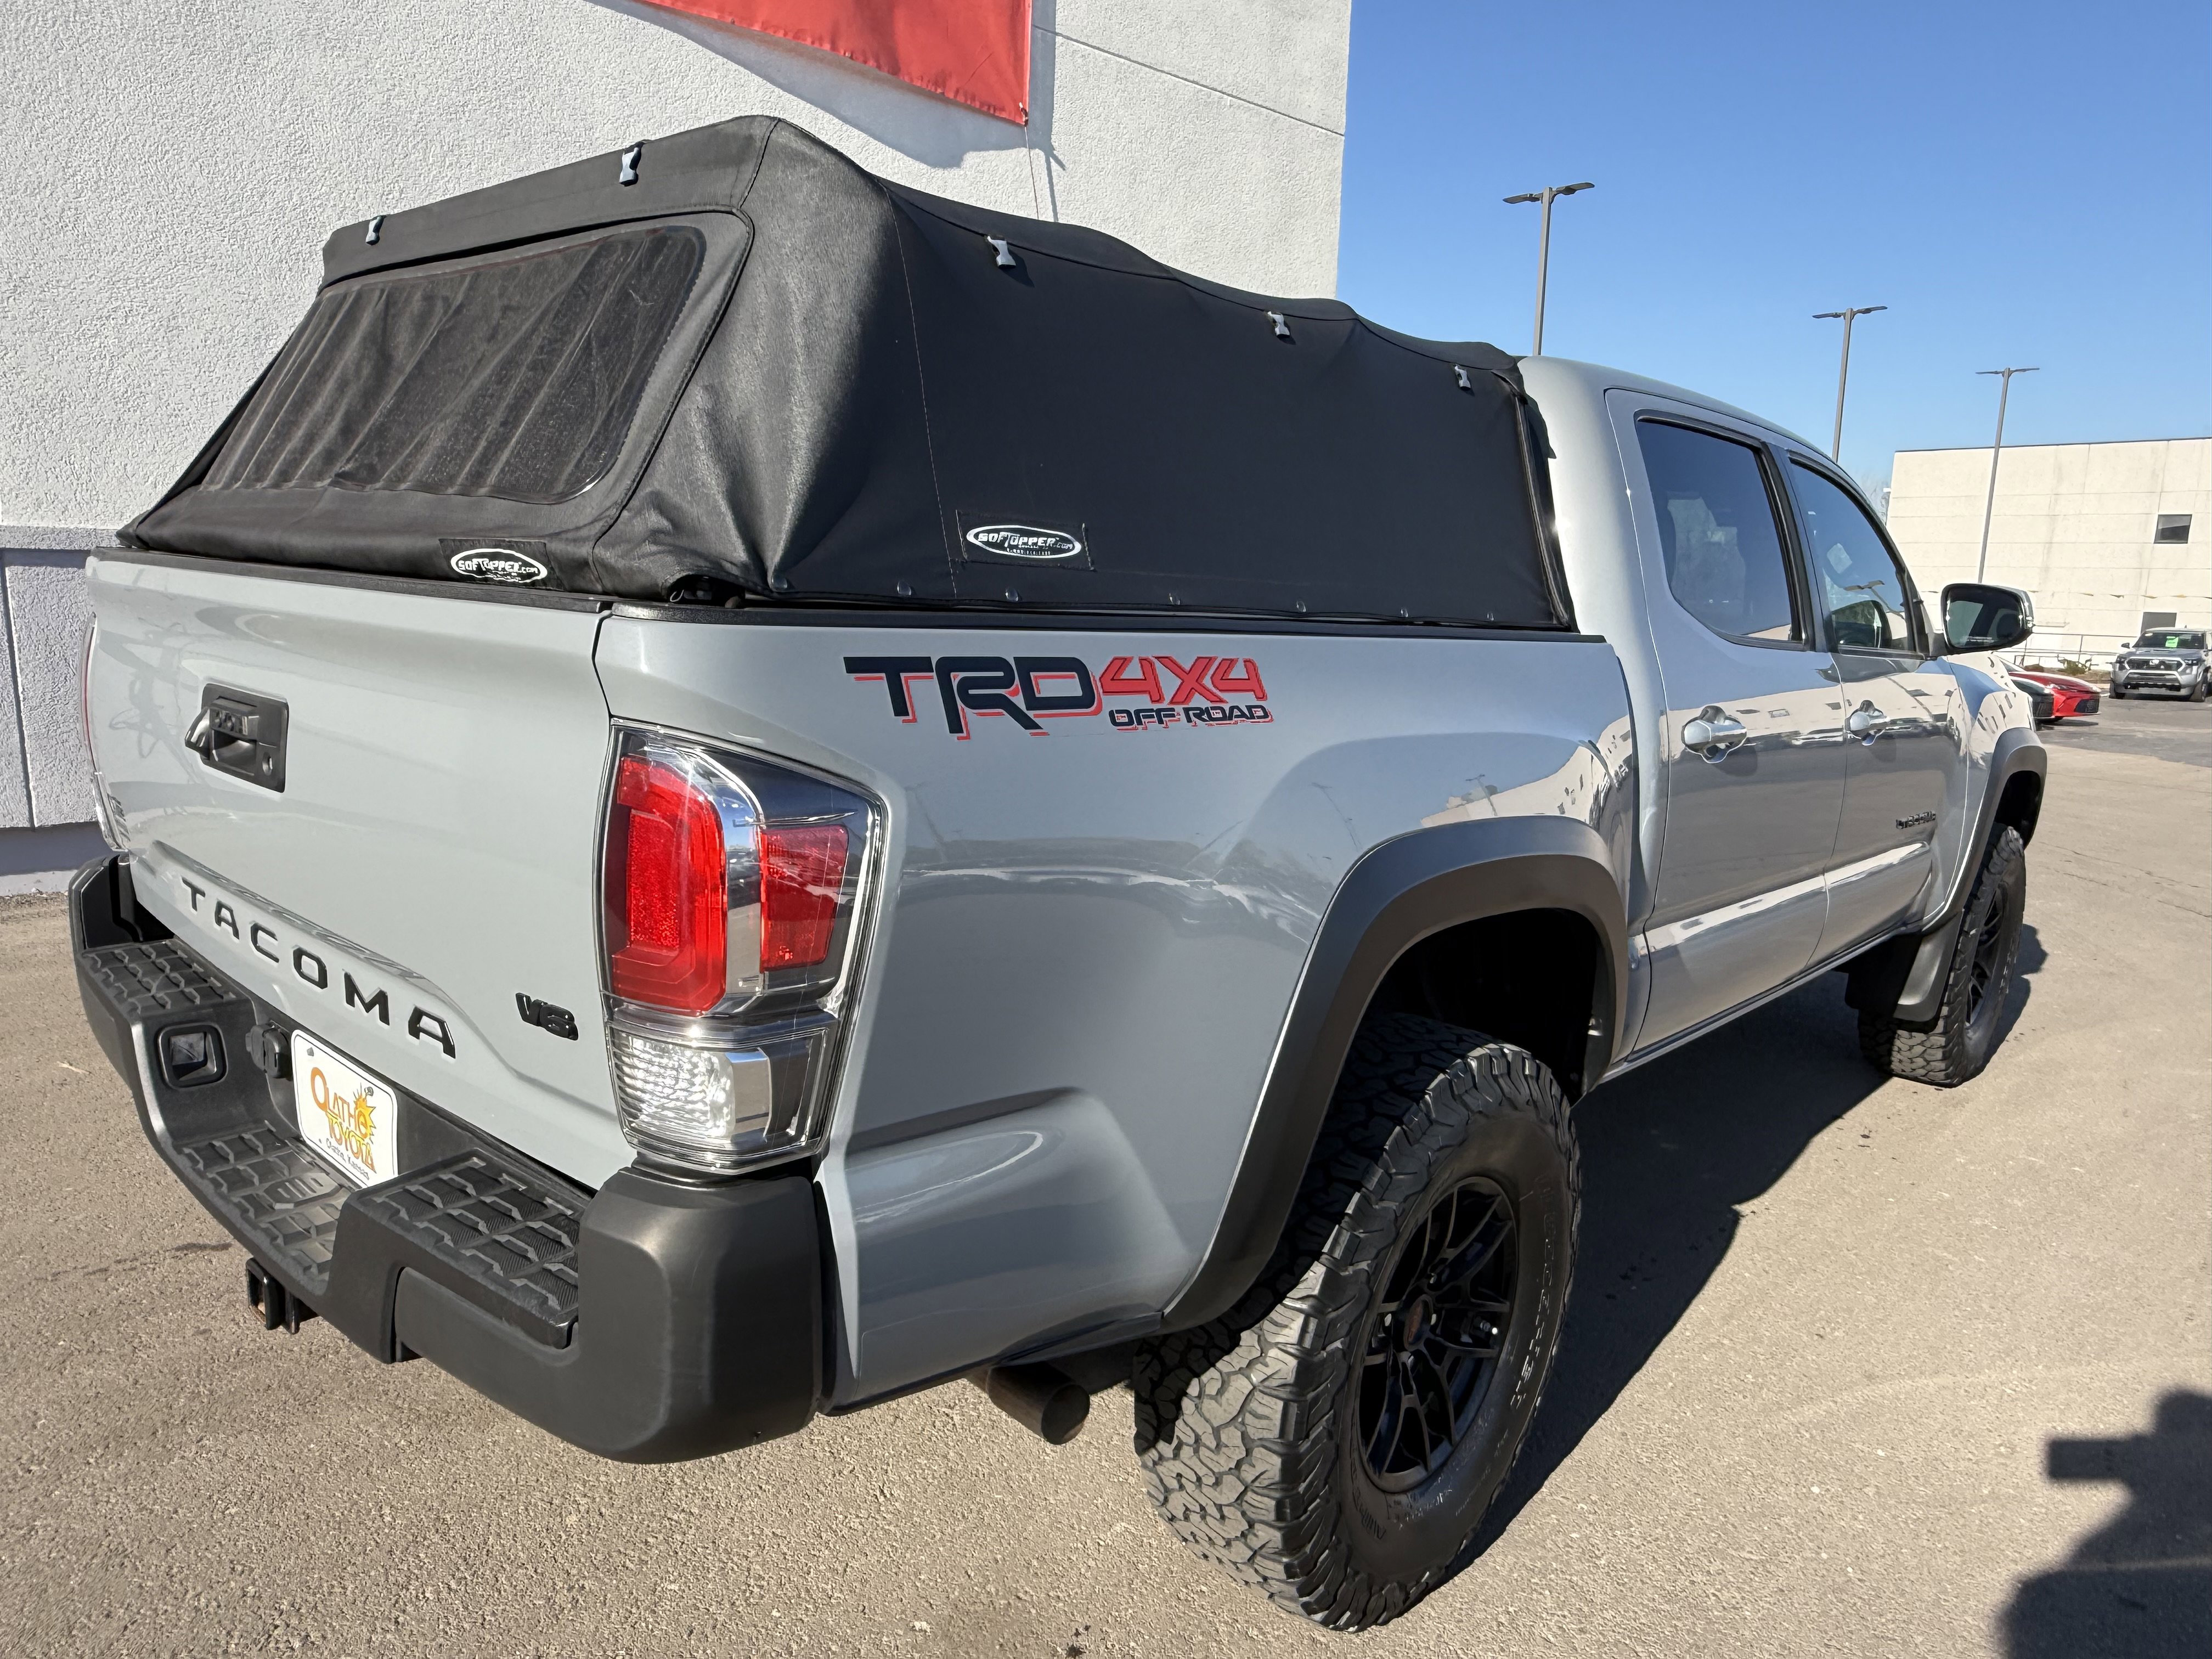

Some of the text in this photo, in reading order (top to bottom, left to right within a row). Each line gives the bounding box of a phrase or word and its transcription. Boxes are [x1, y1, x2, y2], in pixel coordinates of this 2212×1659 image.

[843, 657, 1101, 740] TRD
[1109, 705, 1273, 730] OFF ROAD
[182, 877, 456, 1059] TACOMA
[515, 992, 579, 1041] V6
[326, 1113, 377, 1174] TOYOTA
